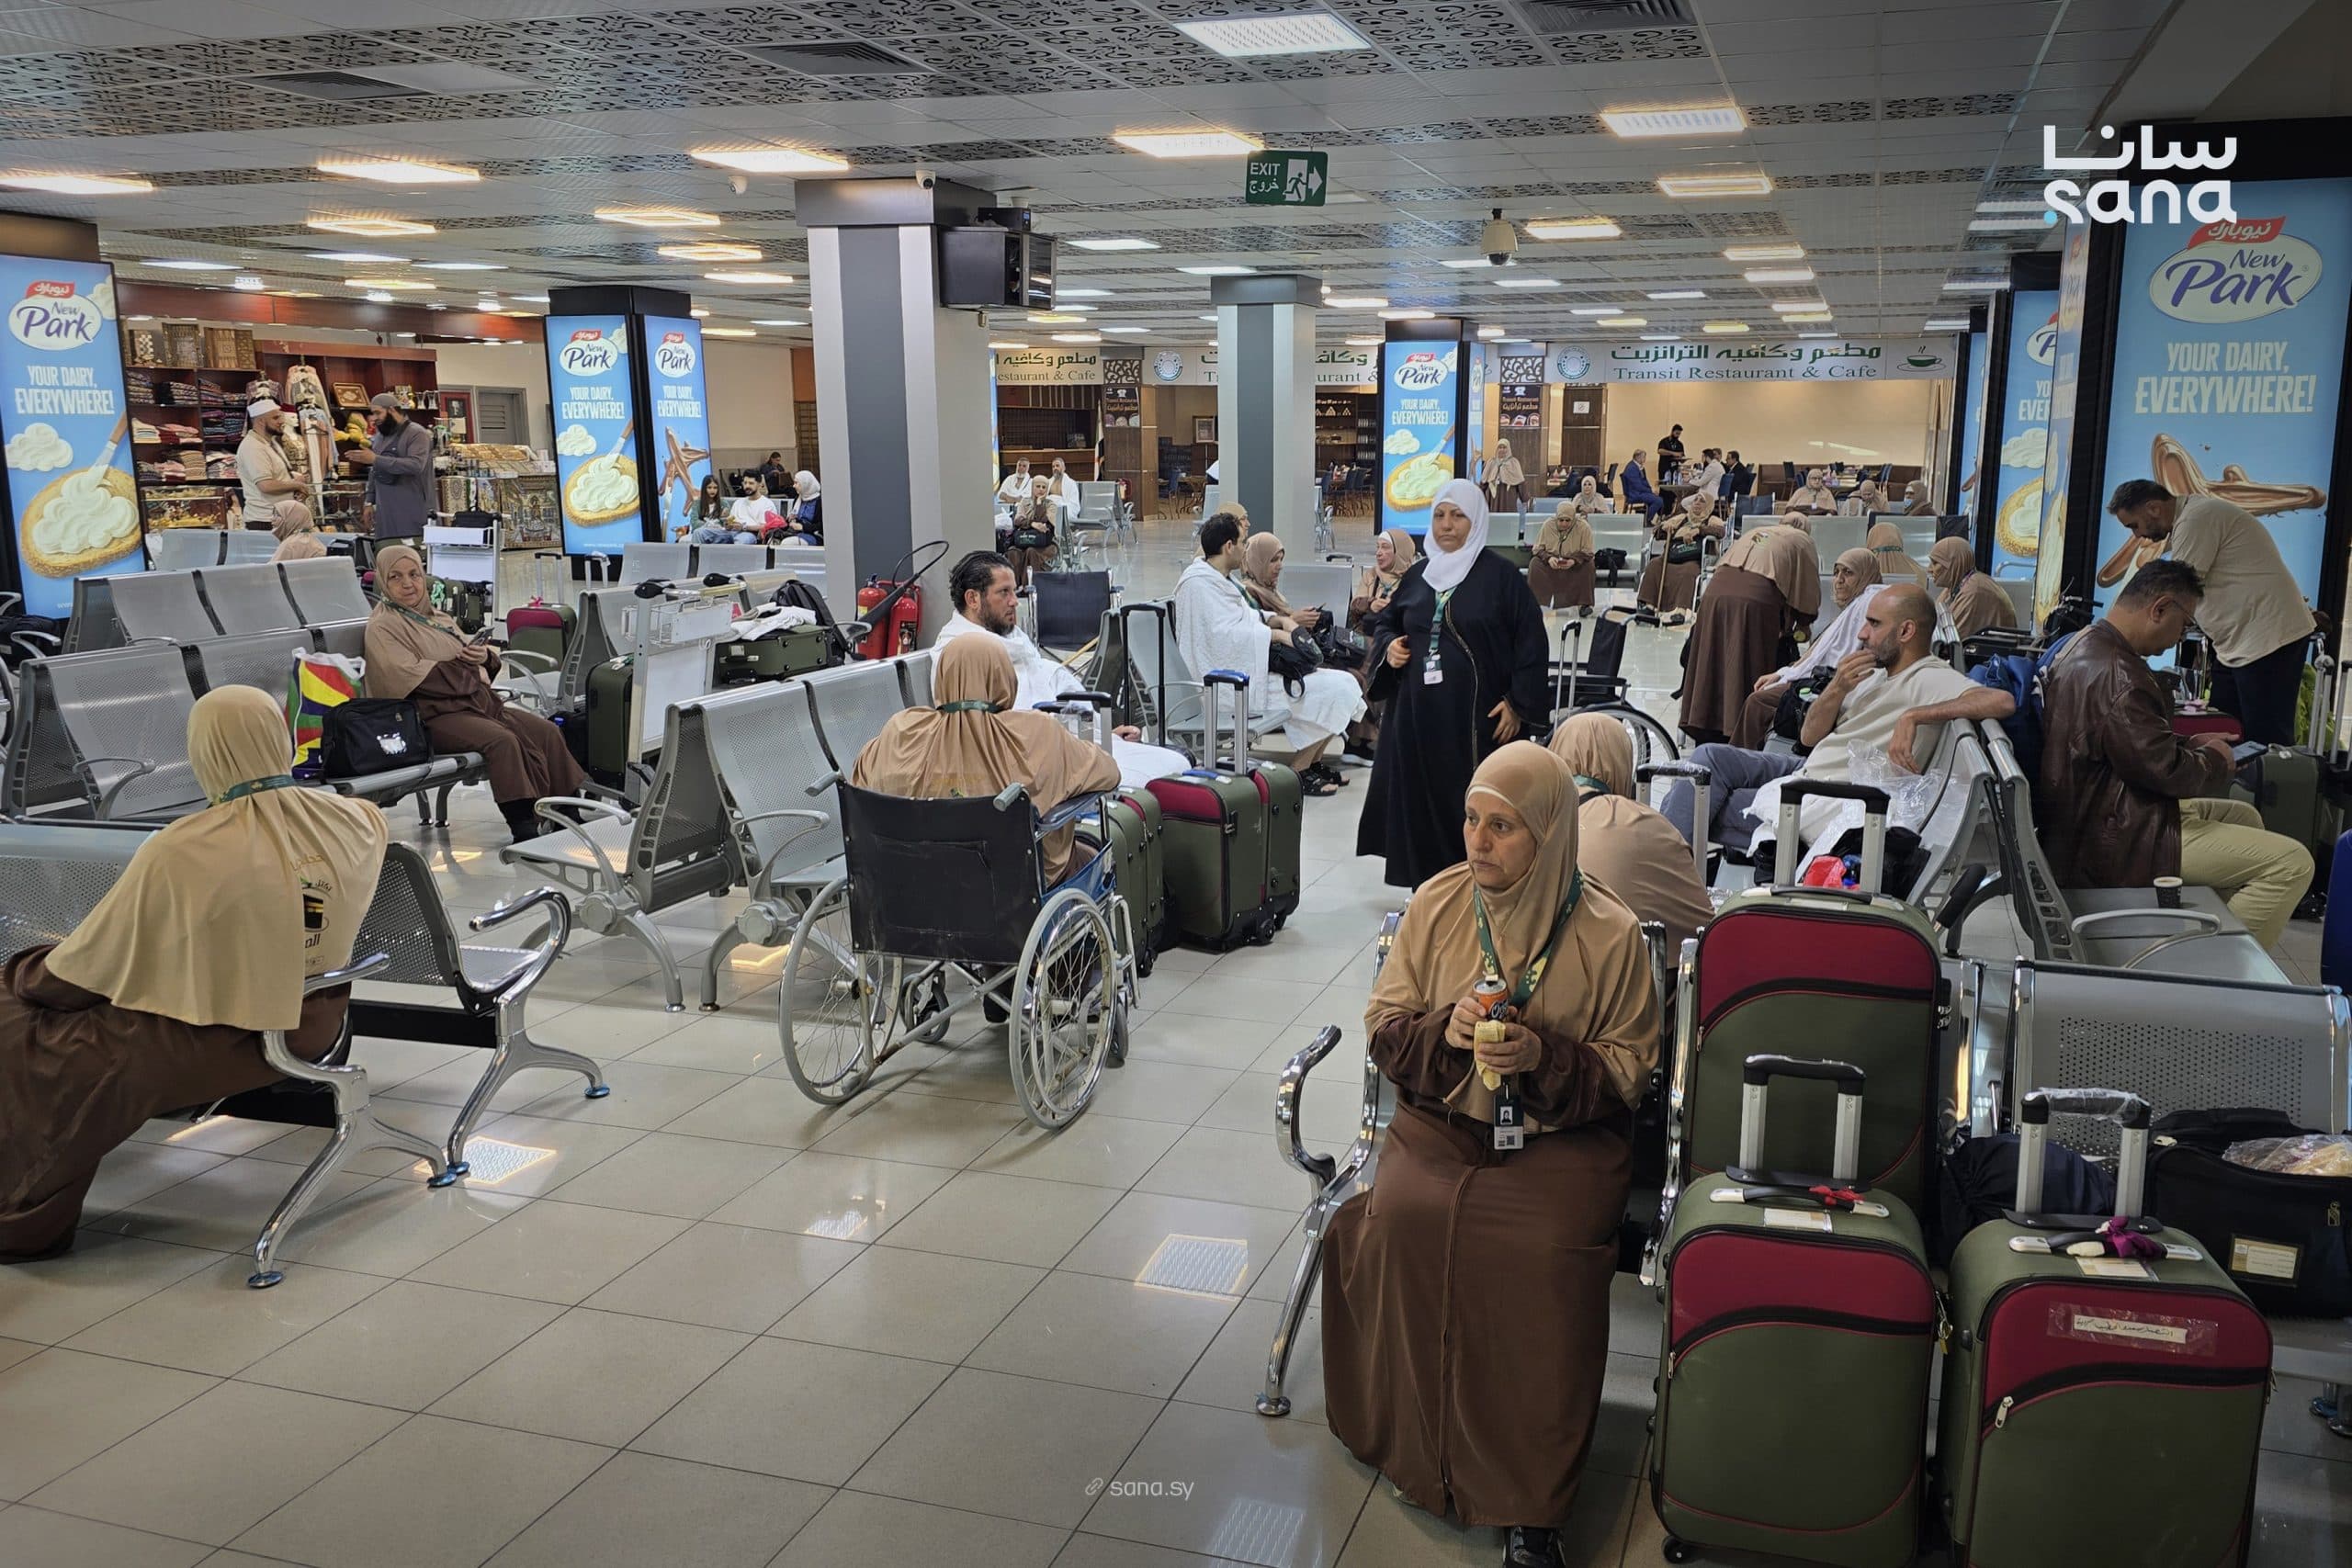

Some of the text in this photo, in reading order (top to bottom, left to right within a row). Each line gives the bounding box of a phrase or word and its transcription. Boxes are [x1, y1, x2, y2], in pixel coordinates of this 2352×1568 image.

[1250, 162, 1281, 176] EXIT
[1250, 177, 1279, 194] خروج
[2208, 220, 2272, 241] نيوبارك
[2229, 249, 2286, 269] New
[2165, 258, 2302, 308] Park
[51, 301, 80, 315] New
[17, 306, 93, 342] Park
[564, 347, 611, 369] Park
[585, 344, 605, 353] New
[1611, 345, 1709, 363] الترانزيت
[1809, 343, 1882, 364] مطعم
[2167, 341, 2290, 373] YOUR DAIRY,
[658, 348, 692, 371] Park
[1057, 352, 1096, 369] مطعم
[28, 366, 97, 389] YOUR DAIRY,
[998, 369, 1096, 381] estaurant & Cafe
[1317, 372, 1362, 382] urant
[1398, 367, 1442, 385] Park
[1613, 365, 1877, 379] Transit Restaurant & Cafe
[570, 387, 589, 400] YOUR
[2036, 379, 2052, 398] YO
[2135, 375, 2318, 414] EVERYWHERE!
[15, 388, 115, 414] EVERYWHERE!
[562, 400, 625, 419] EVERYWHERE!
